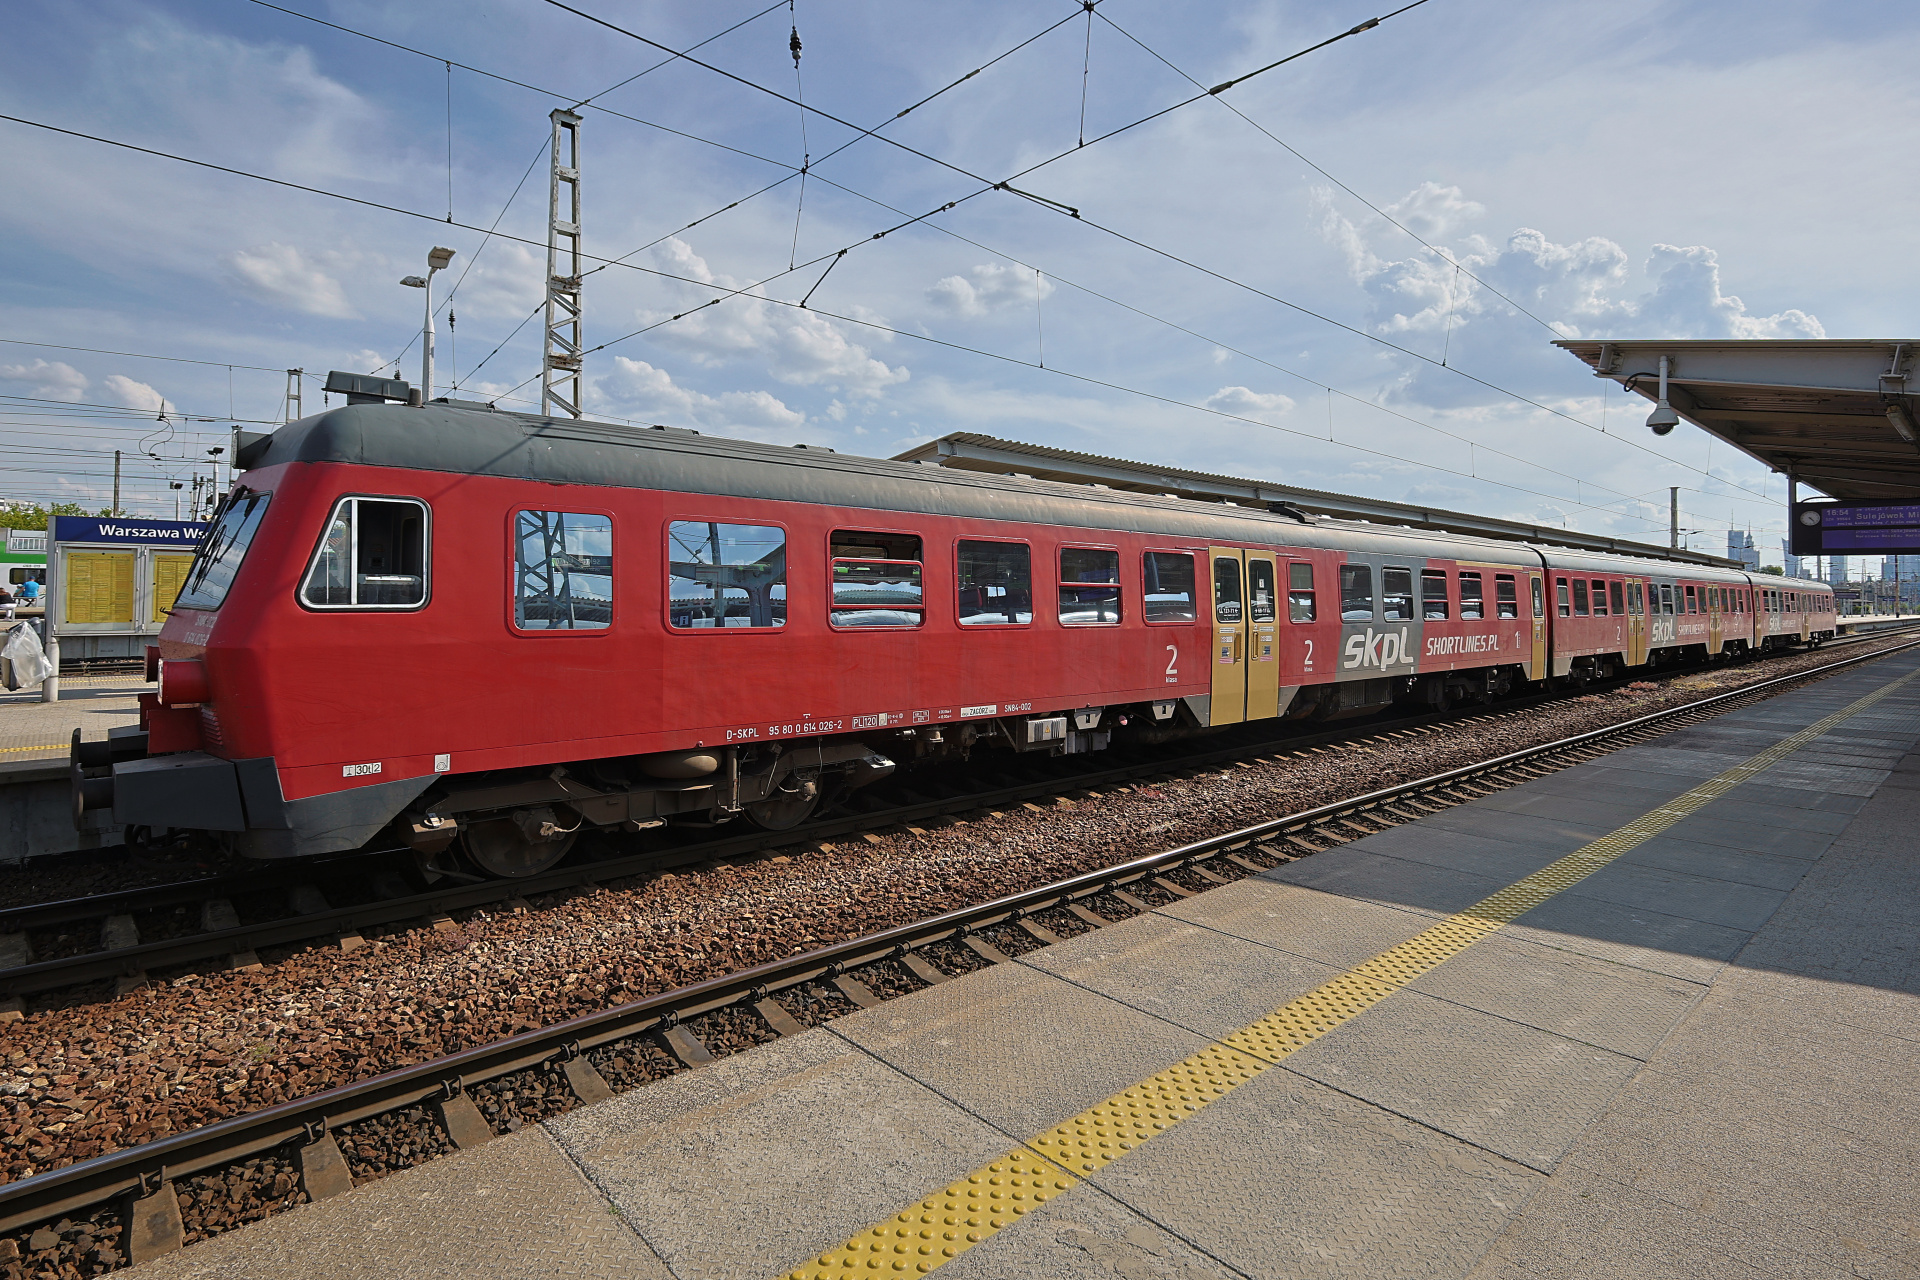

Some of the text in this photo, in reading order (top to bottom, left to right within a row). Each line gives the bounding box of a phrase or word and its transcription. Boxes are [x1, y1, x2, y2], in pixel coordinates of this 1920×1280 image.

[99, 524, 209, 539] Warszawa Ws
[1616, 626, 1621, 640] 2
[1304, 639, 1313, 665] 2
[1425, 634, 1499, 656] SHORTLINES.PL
[1165, 644, 1178, 675] 2
[1004, 702, 1032, 713] SN84-002
[853, 718, 863, 728] PL
[864, 716, 876, 726] 120
[726, 720, 843, 740] D-SKPL 95 80 0 614 026-2
[374, 764, 380, 772] 2
